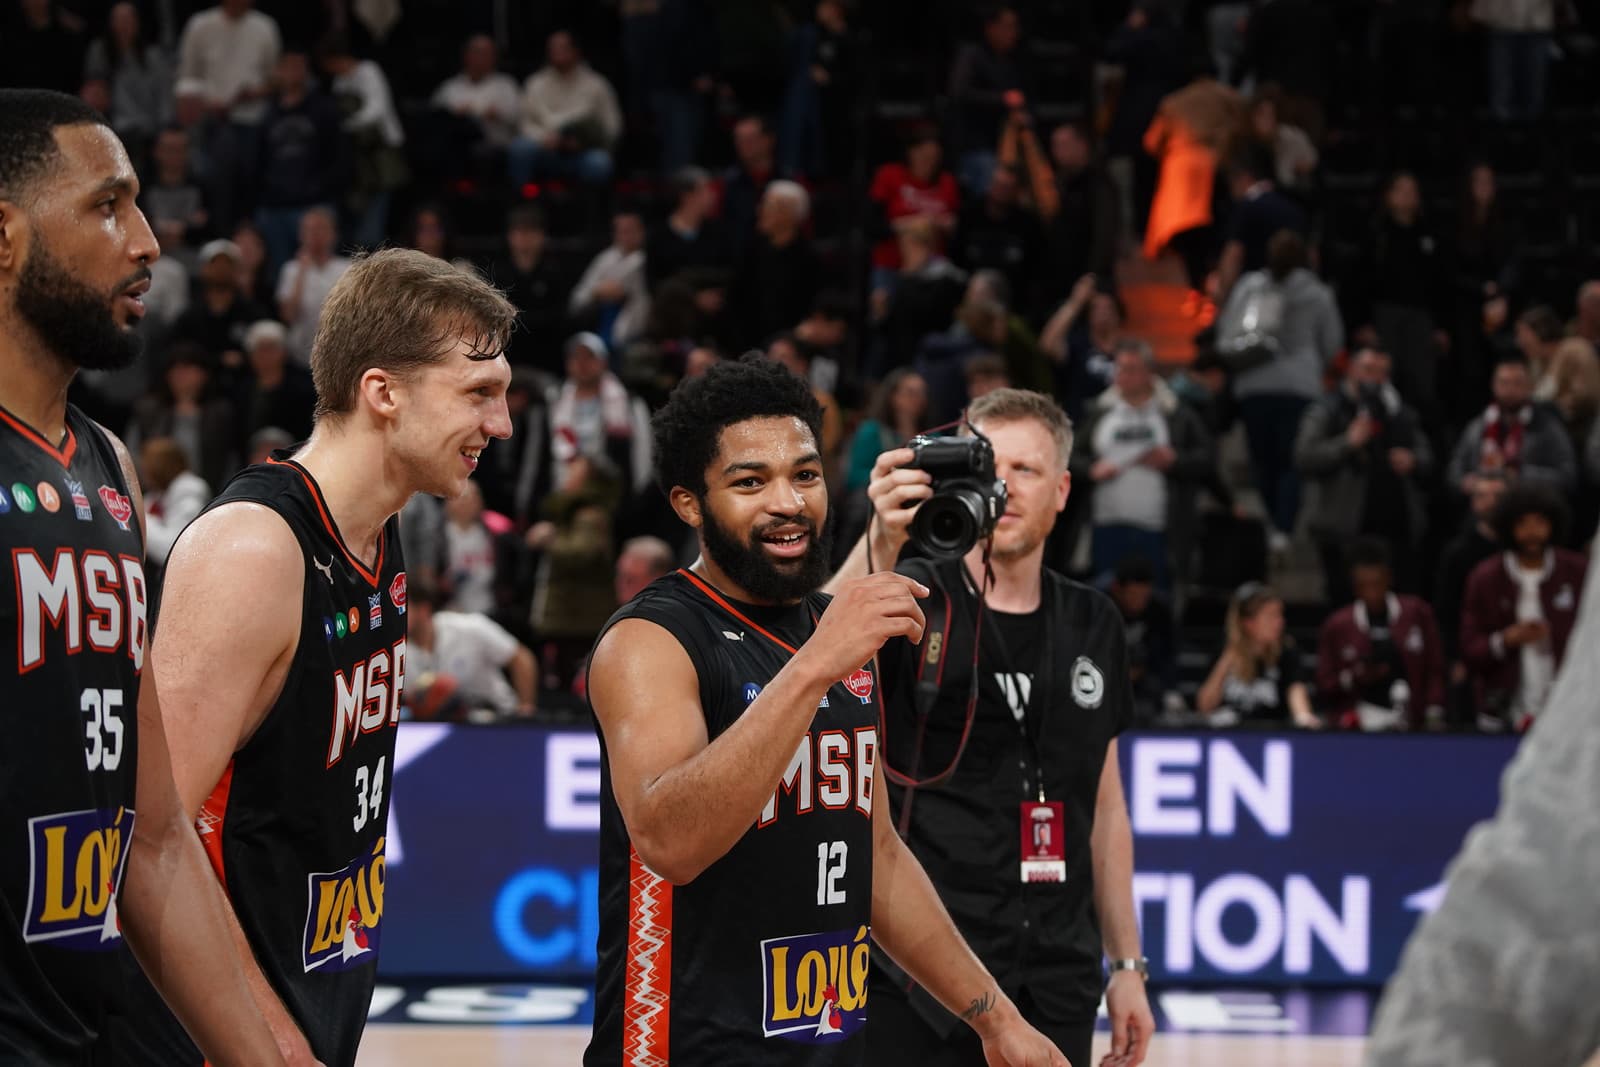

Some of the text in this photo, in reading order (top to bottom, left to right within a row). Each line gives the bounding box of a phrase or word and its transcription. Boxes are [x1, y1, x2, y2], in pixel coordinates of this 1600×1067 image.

[12, 547, 147, 675] MSB
[80, 688, 124, 771] 35
[353, 755, 386, 833] 34
[758, 726, 877, 829] MSB
[817, 841, 848, 906] 12
